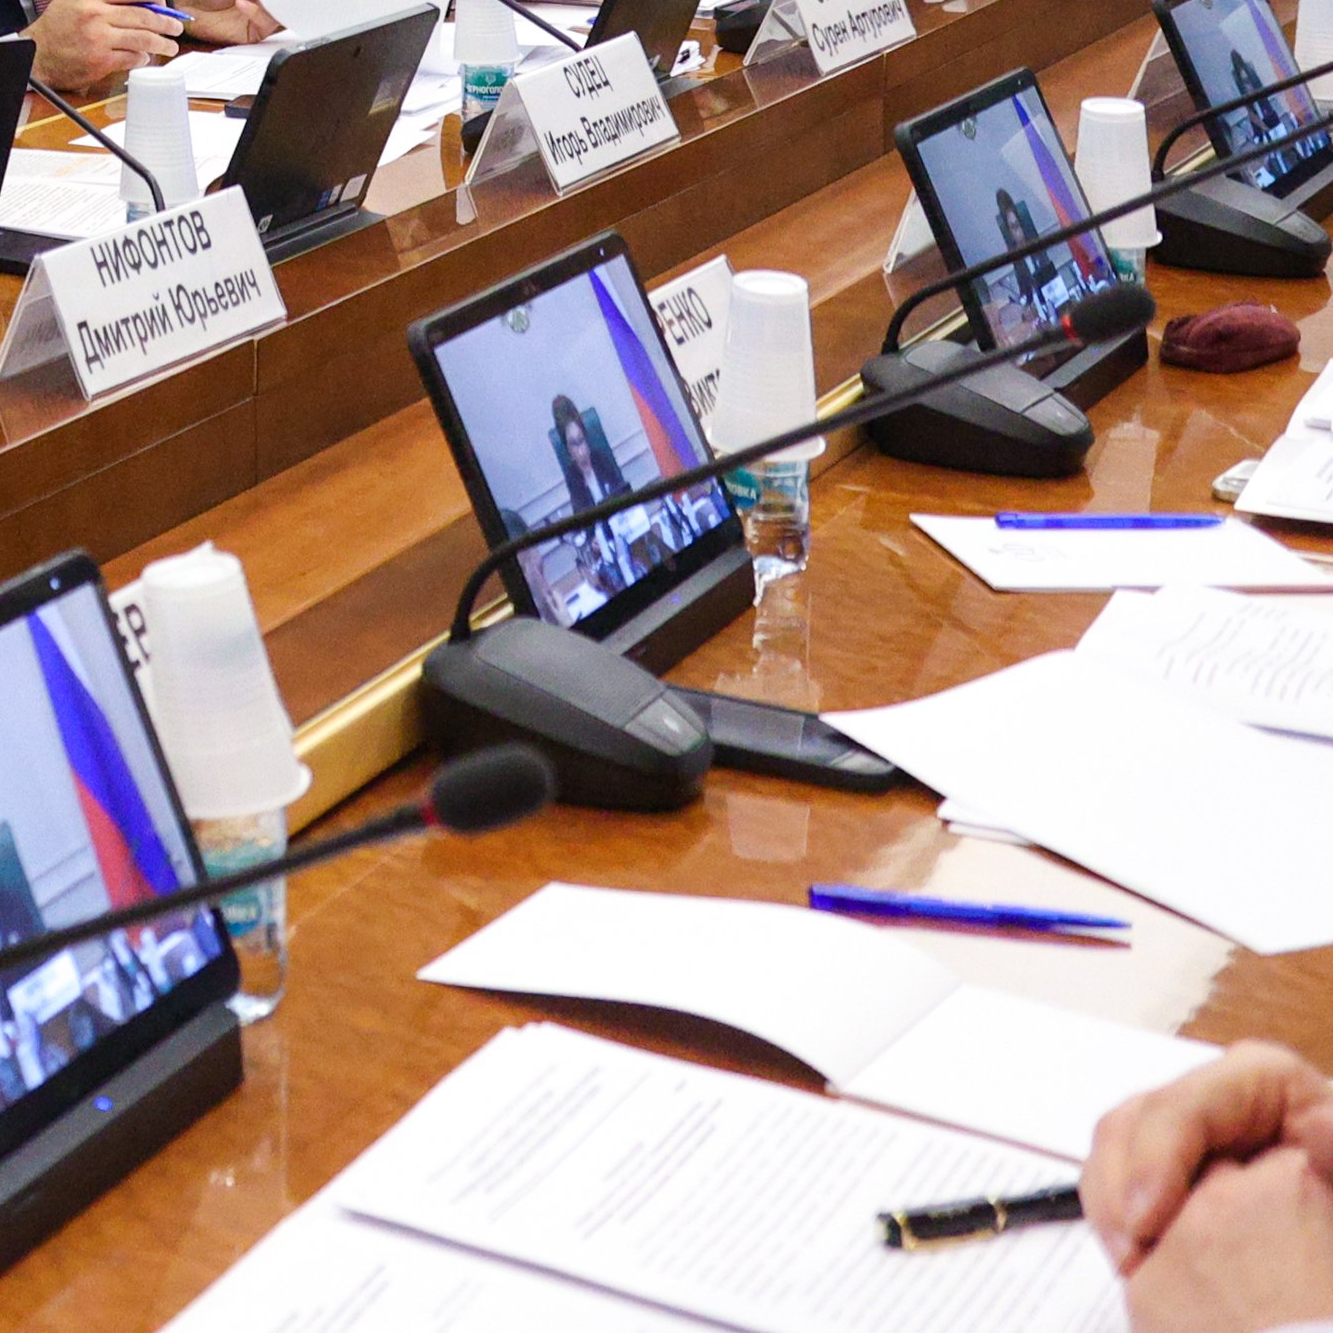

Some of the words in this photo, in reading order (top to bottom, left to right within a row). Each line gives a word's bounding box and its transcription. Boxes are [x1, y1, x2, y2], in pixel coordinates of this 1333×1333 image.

[812, 21, 851, 57] Сурен
[847, 0, 905, 43] Артурович
[563, 55, 614, 100] СУДЕЦ
[544, 130, 589, 166] Игорь
[580, 95, 666, 147] Владимирович
[90, 210, 212, 288] НИФОНТОВ
[77, 294, 174, 374] Дмитрий
[168, 269, 262, 332] Юрьевич
